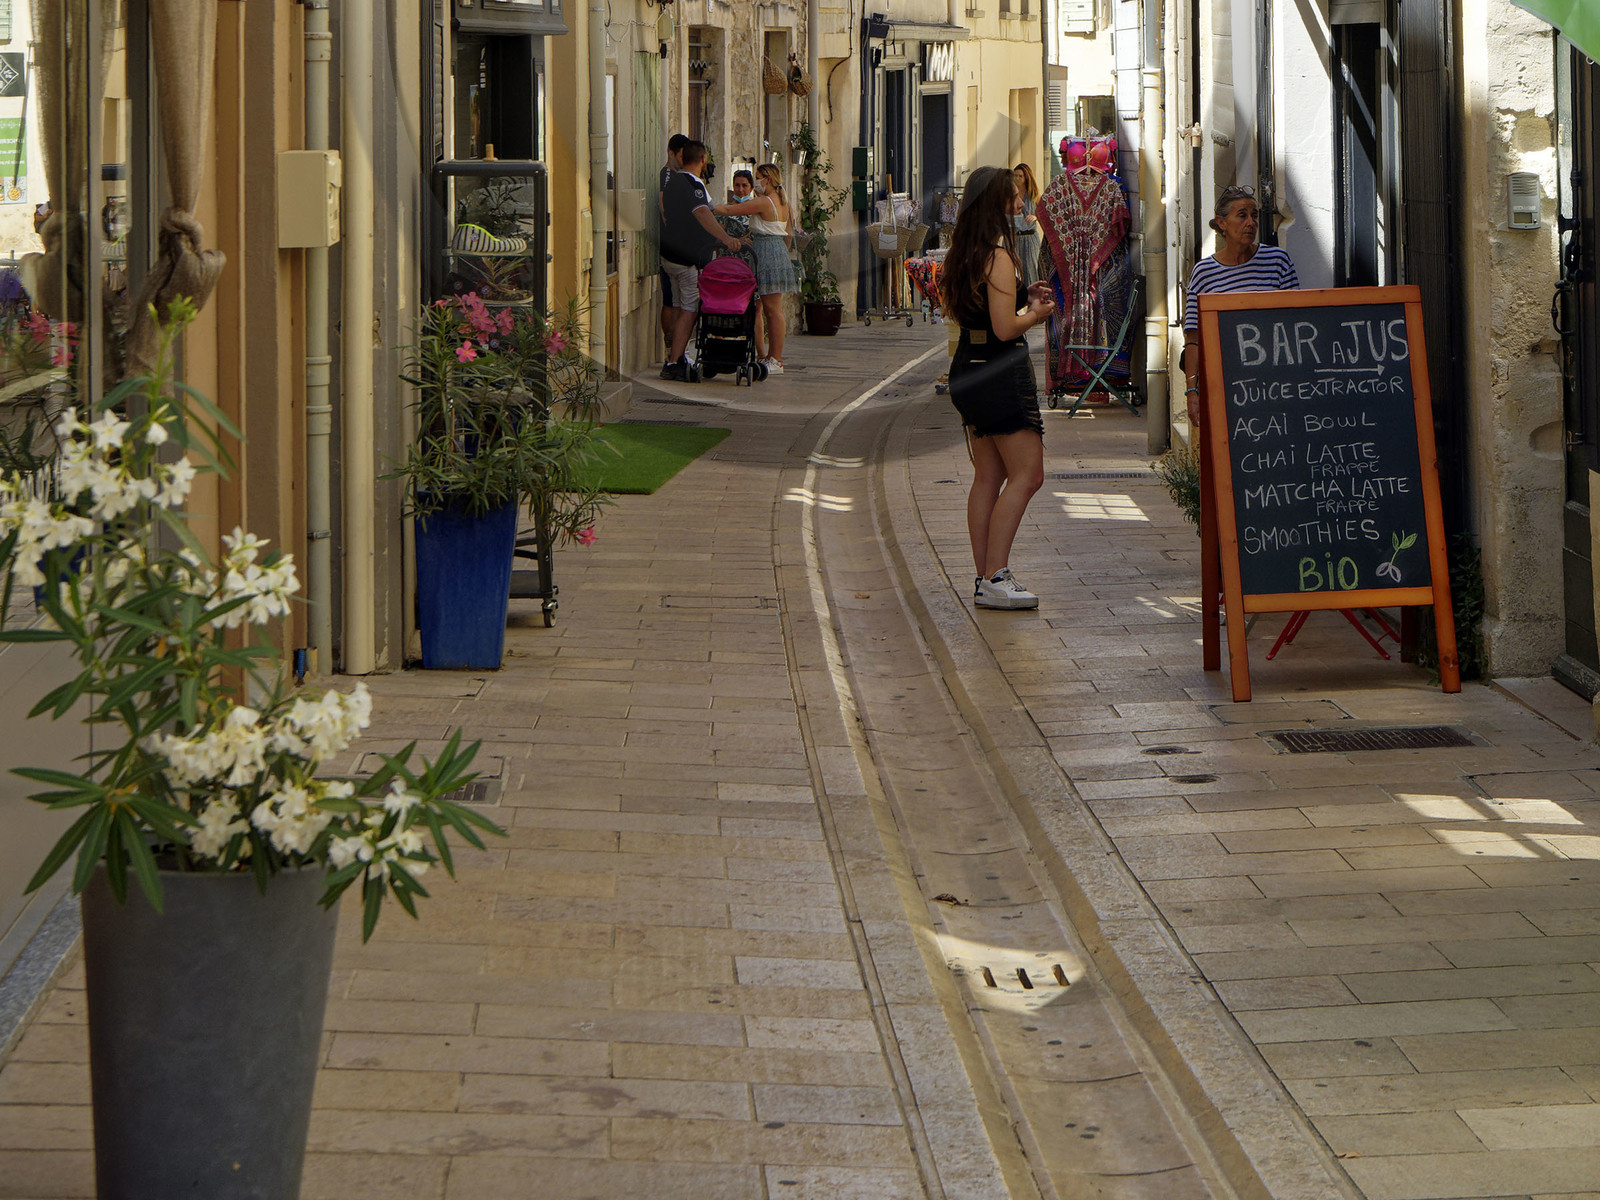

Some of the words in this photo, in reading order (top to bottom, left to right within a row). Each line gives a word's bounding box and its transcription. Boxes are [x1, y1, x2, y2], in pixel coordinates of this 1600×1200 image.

[1236, 320, 1321, 367] BAR
[1341, 319, 1409, 365] JUS
[1298, 375, 1404, 400] EXTRACTOR
[1303, 411, 1377, 433] BOWL
[1306, 442, 1376, 465] LATTE
[1244, 479, 1345, 510] MATCHA
[1351, 476, 1410, 499] LATTE
